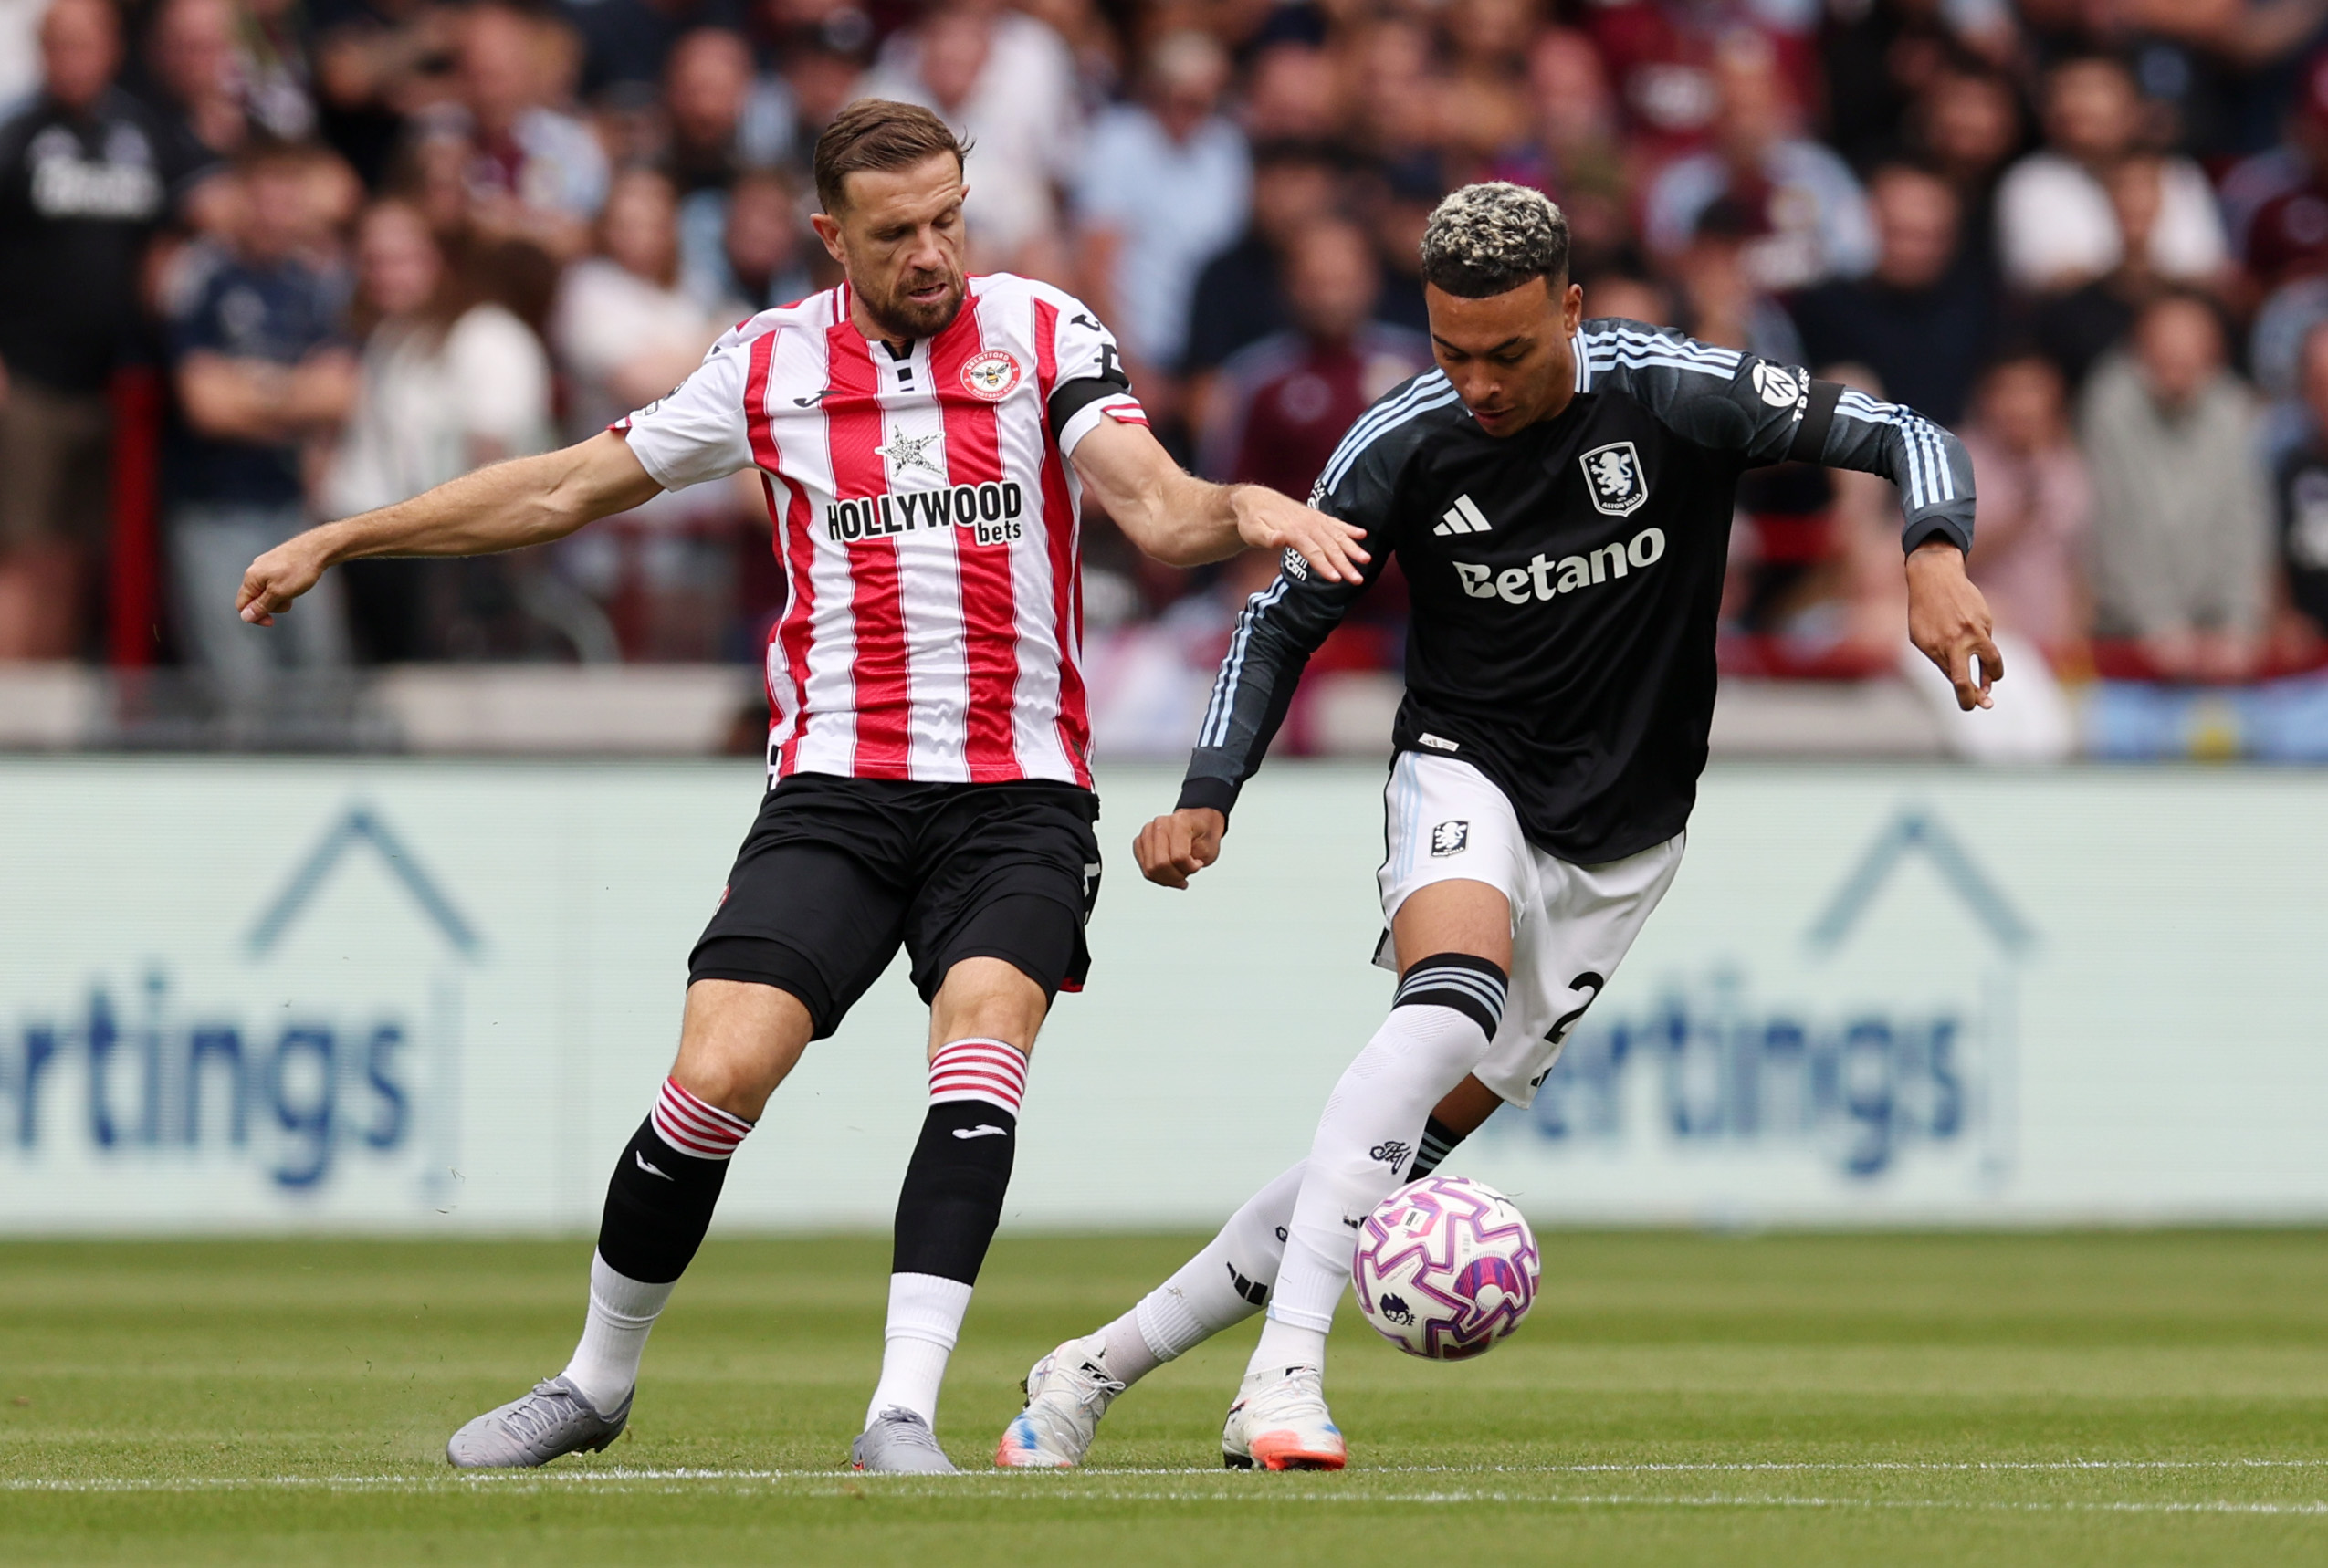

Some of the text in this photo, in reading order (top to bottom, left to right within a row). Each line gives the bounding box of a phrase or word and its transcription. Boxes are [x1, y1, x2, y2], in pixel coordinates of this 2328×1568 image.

[966, 352, 1010, 371] BRENTFORD
[826, 482, 1022, 541] HOLLYWOOD
[1601, 501, 1625, 509] ASTON
[1624, 493, 1641, 507] VILLA
[977, 520, 1022, 543] bets
[1452, 527, 1666, 605] Betano
[1543, 971, 1605, 1045] 2
[0, 973, 411, 1189] rtings
